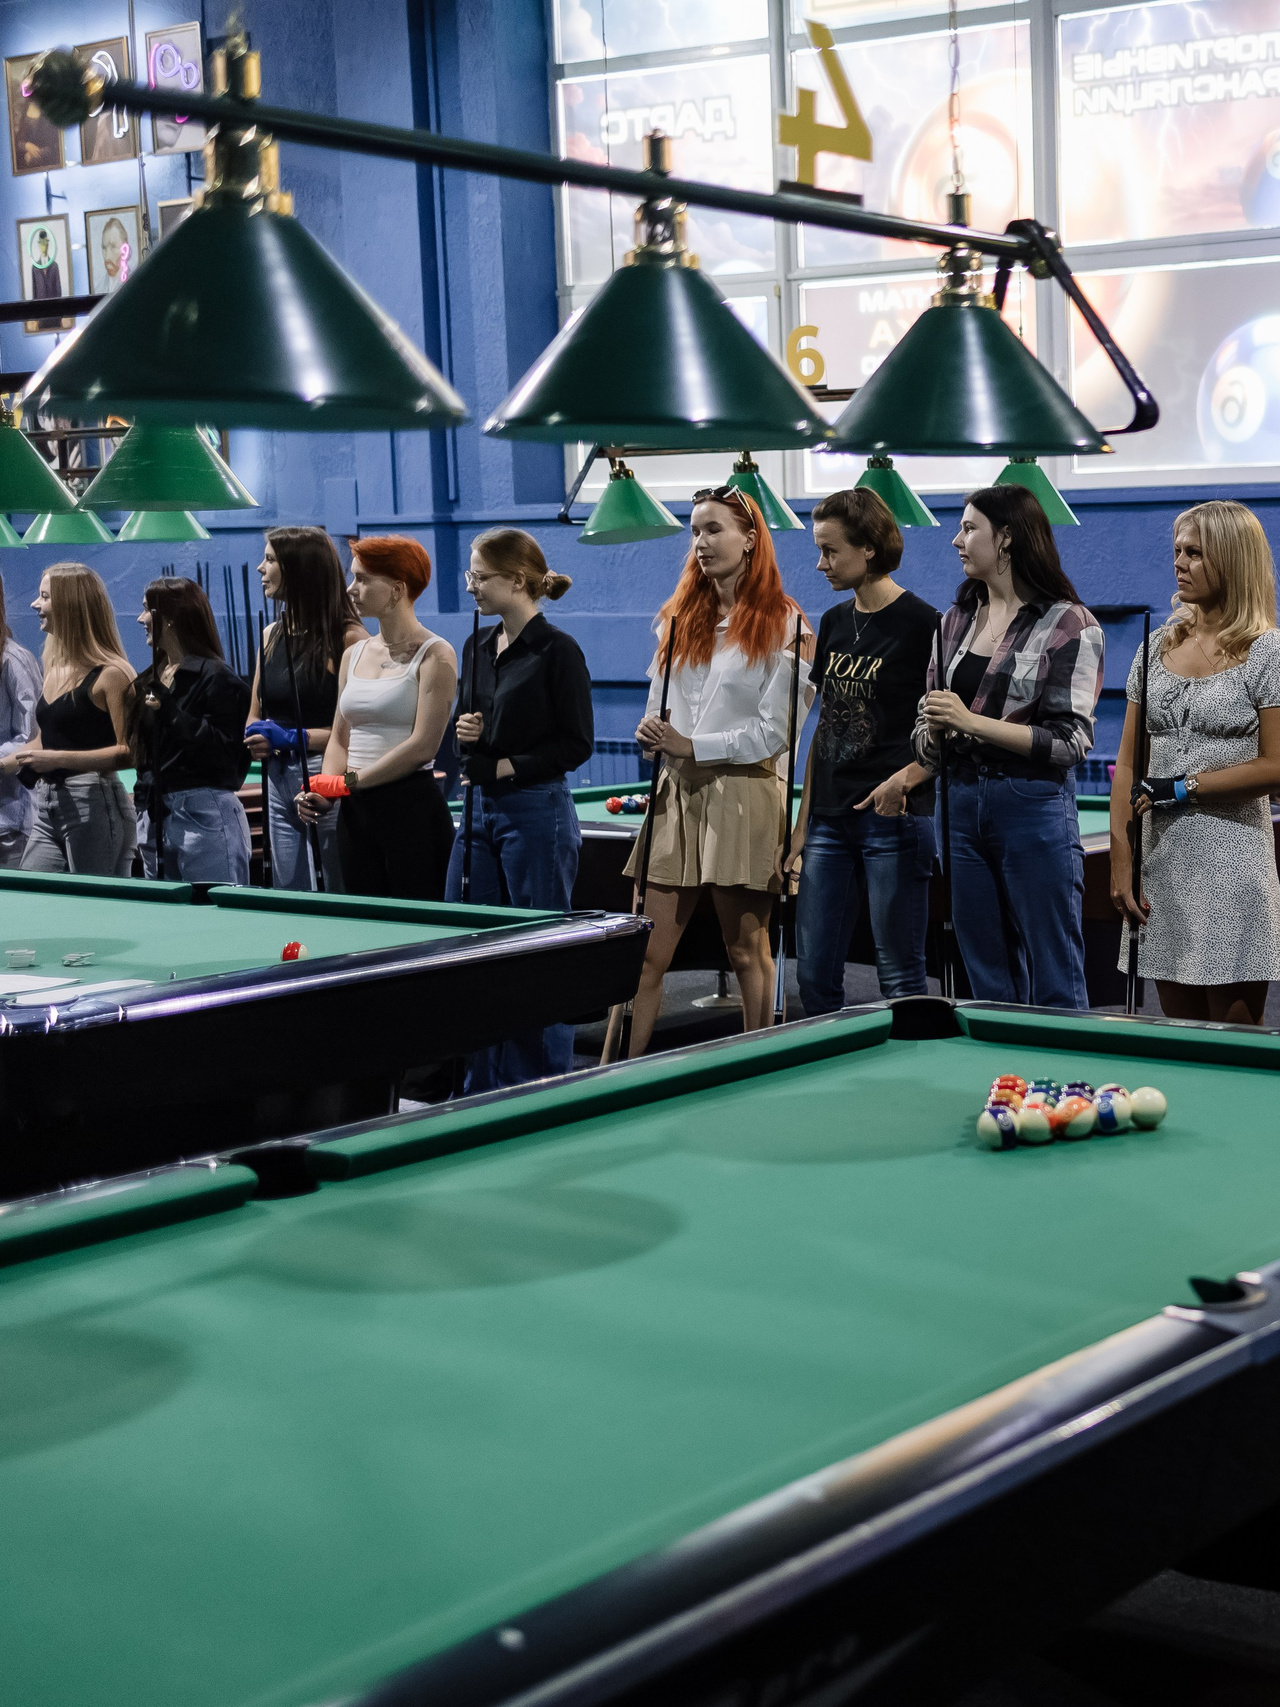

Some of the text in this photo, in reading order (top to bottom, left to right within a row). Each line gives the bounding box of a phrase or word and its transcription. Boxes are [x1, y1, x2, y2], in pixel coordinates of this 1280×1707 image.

[786, 324, 825, 386] 6
[825, 651, 883, 681] YOUR
[822, 677, 876, 700] UNSHINE
